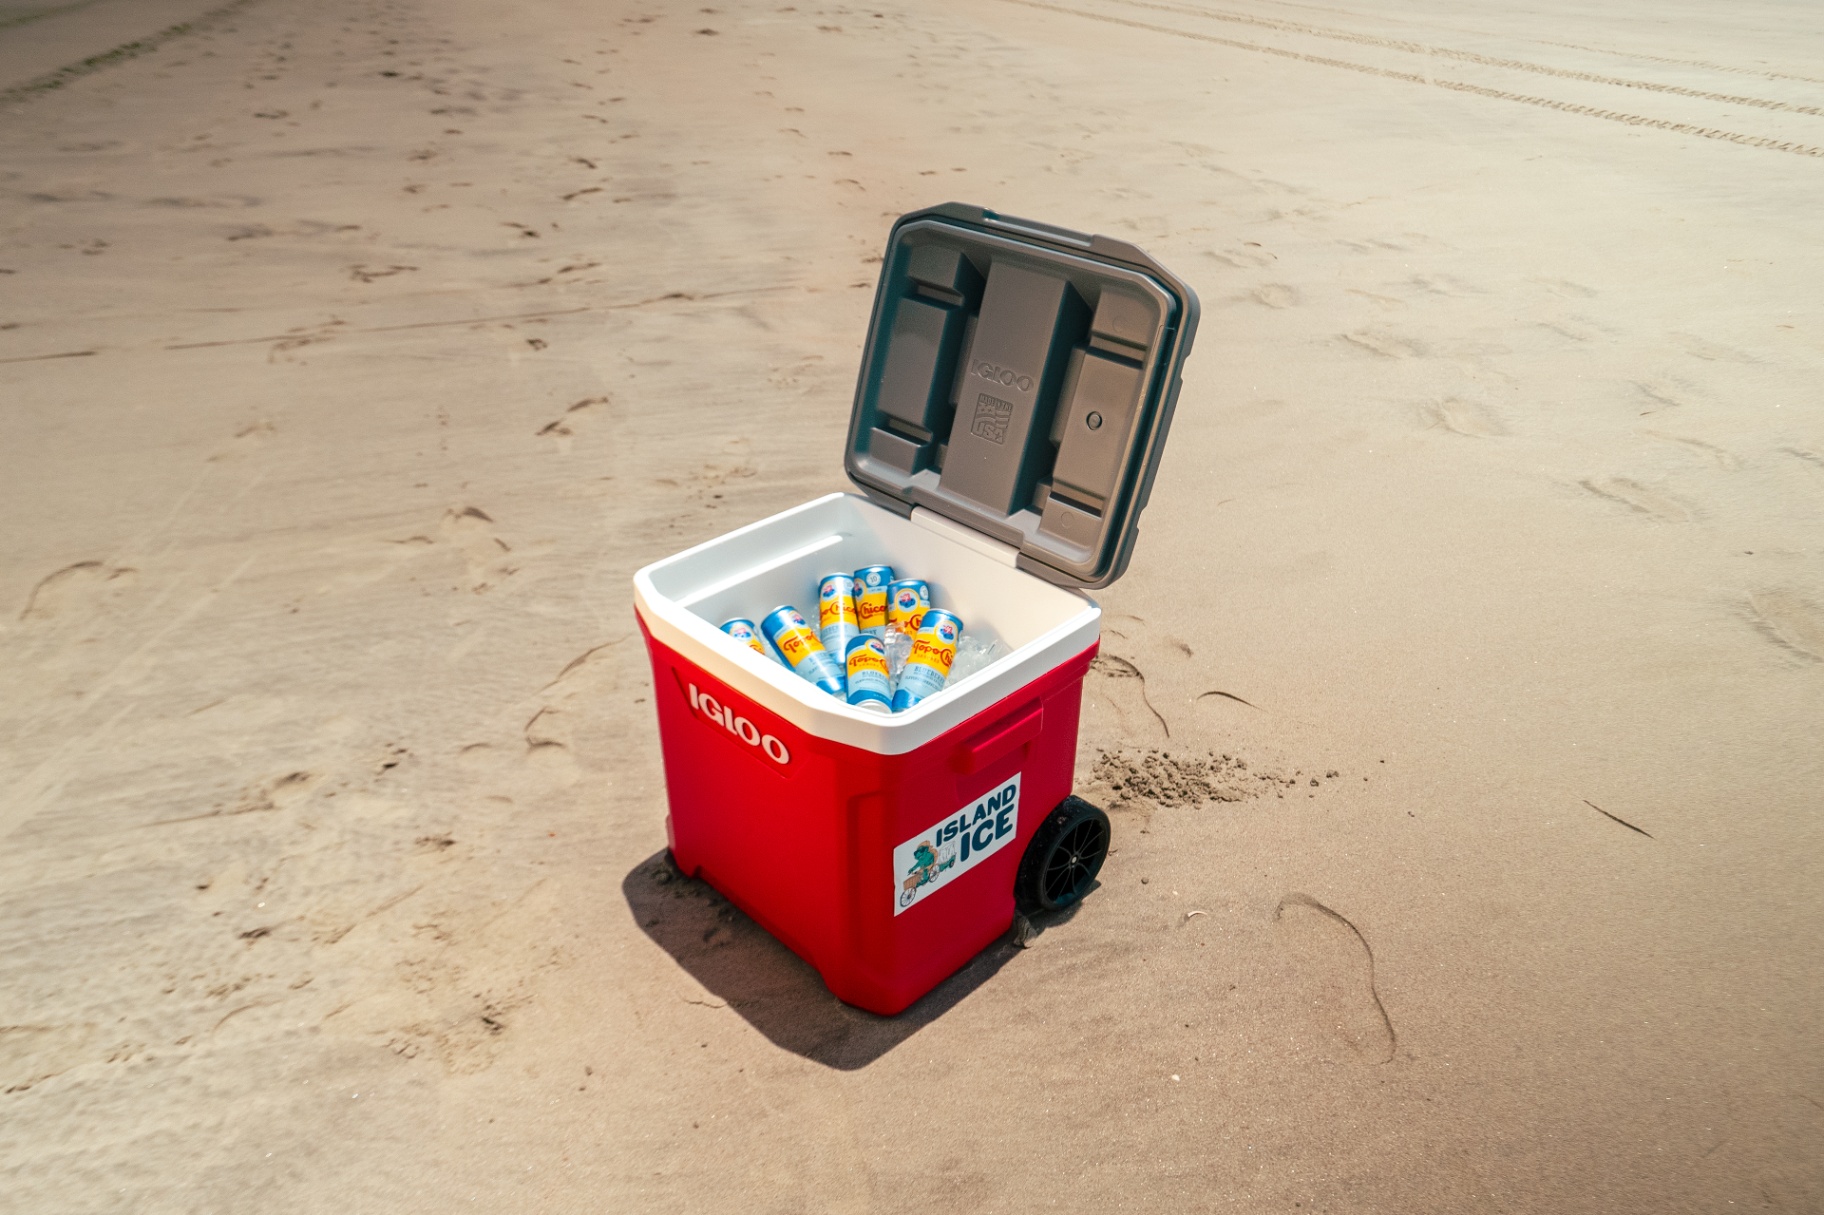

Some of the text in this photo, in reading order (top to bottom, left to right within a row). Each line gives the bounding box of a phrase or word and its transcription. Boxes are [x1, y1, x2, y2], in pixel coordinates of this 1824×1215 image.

[971, 359, 1034, 392] IGLOO
[979, 394, 995, 406] MADE
[972, 421, 1004, 443] USA
[860, 601, 887, 619] Chico
[848, 653, 879, 667] Topo
[914, 639, 940, 655] Topo
[940, 648, 953, 668] Chi
[688, 682, 790, 765] IGLOO
[936, 784, 1017, 847] ISLAND
[960, 803, 1015, 862] ICE
